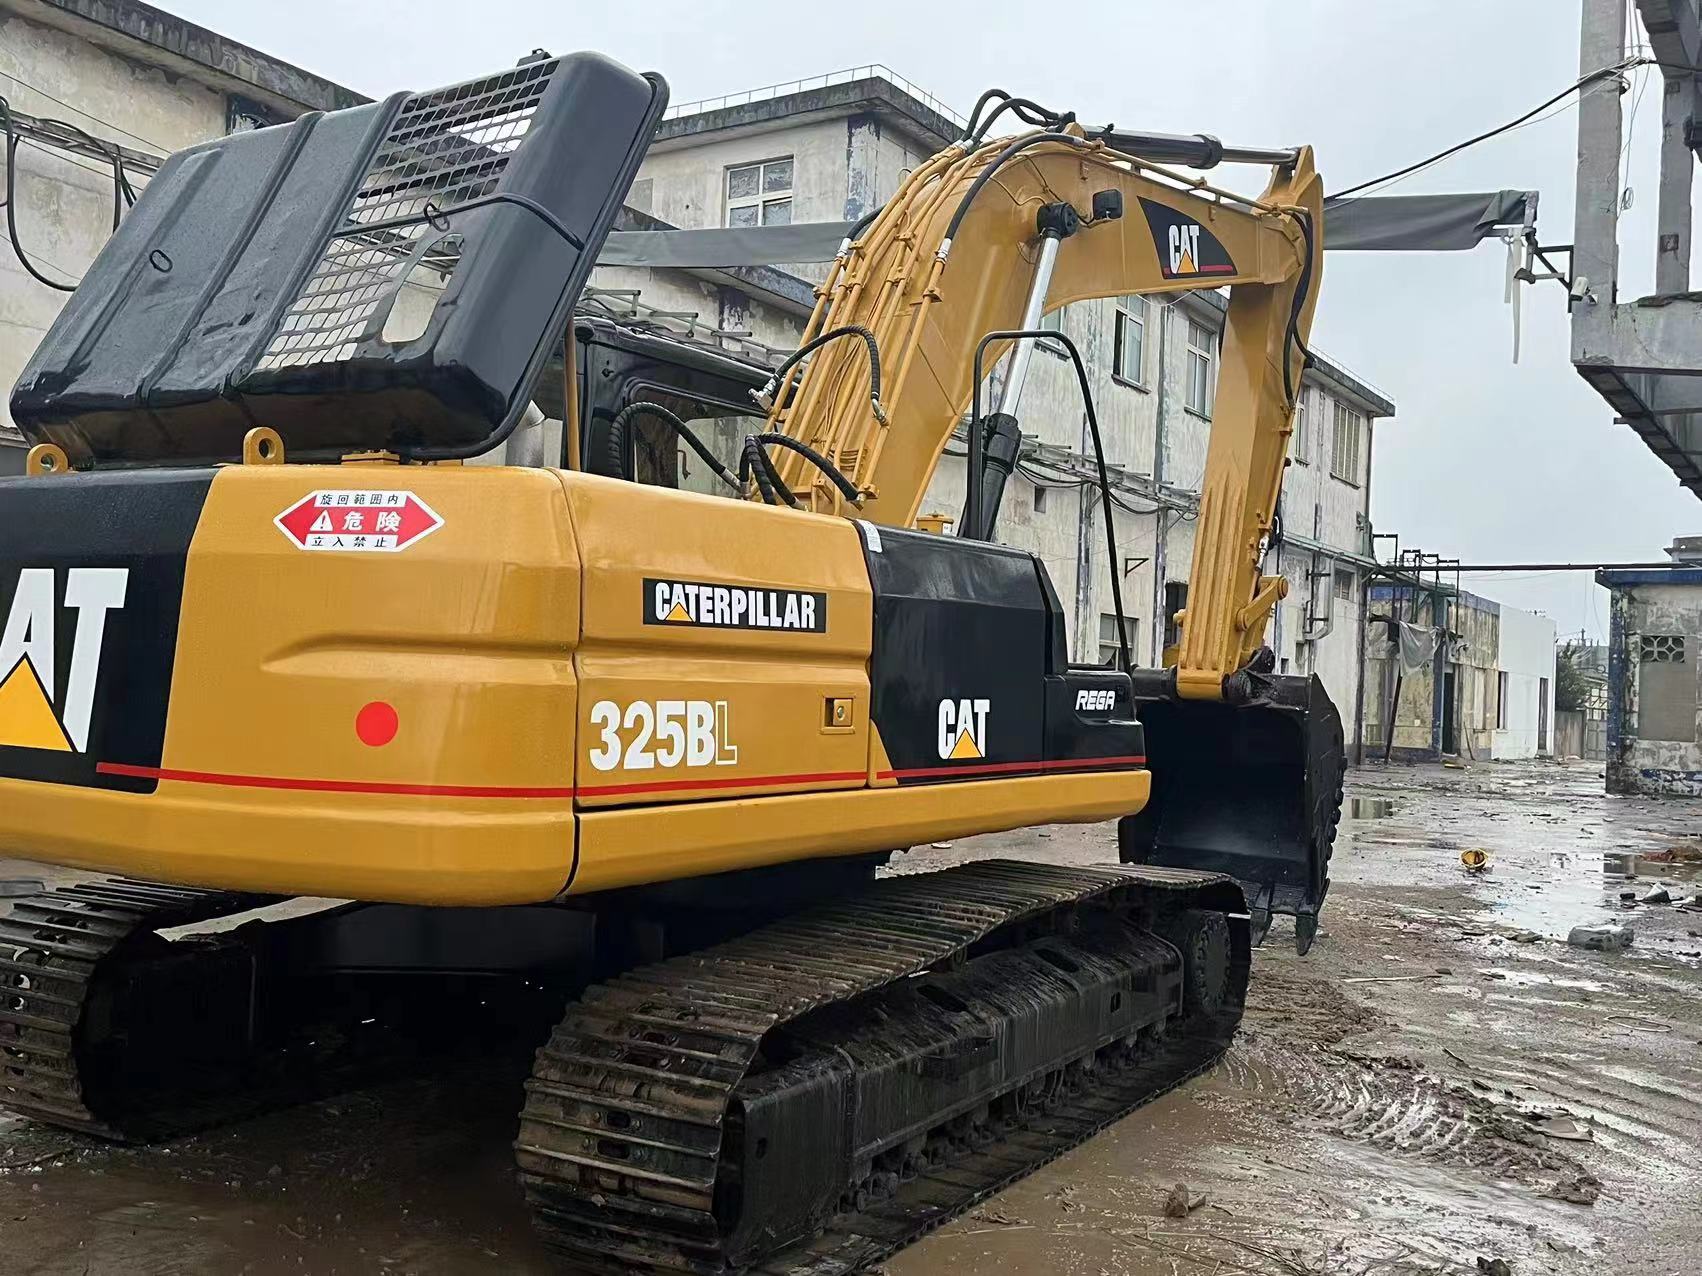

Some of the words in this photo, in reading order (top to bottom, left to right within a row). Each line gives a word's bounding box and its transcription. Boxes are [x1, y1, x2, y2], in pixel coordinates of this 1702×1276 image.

[1168, 224, 1200, 274] CAT
[320, 493, 399, 506] 旋回範囲内
[341, 511, 402, 532] 危険
[311, 536, 387, 548] 立入禁止
[654, 582, 816, 629] CATERPILLAR
[0, 568, 129, 753] AT
[1075, 690, 1116, 710] REGA
[588, 700, 738, 772] 325BL
[938, 698, 990, 760] CAT
